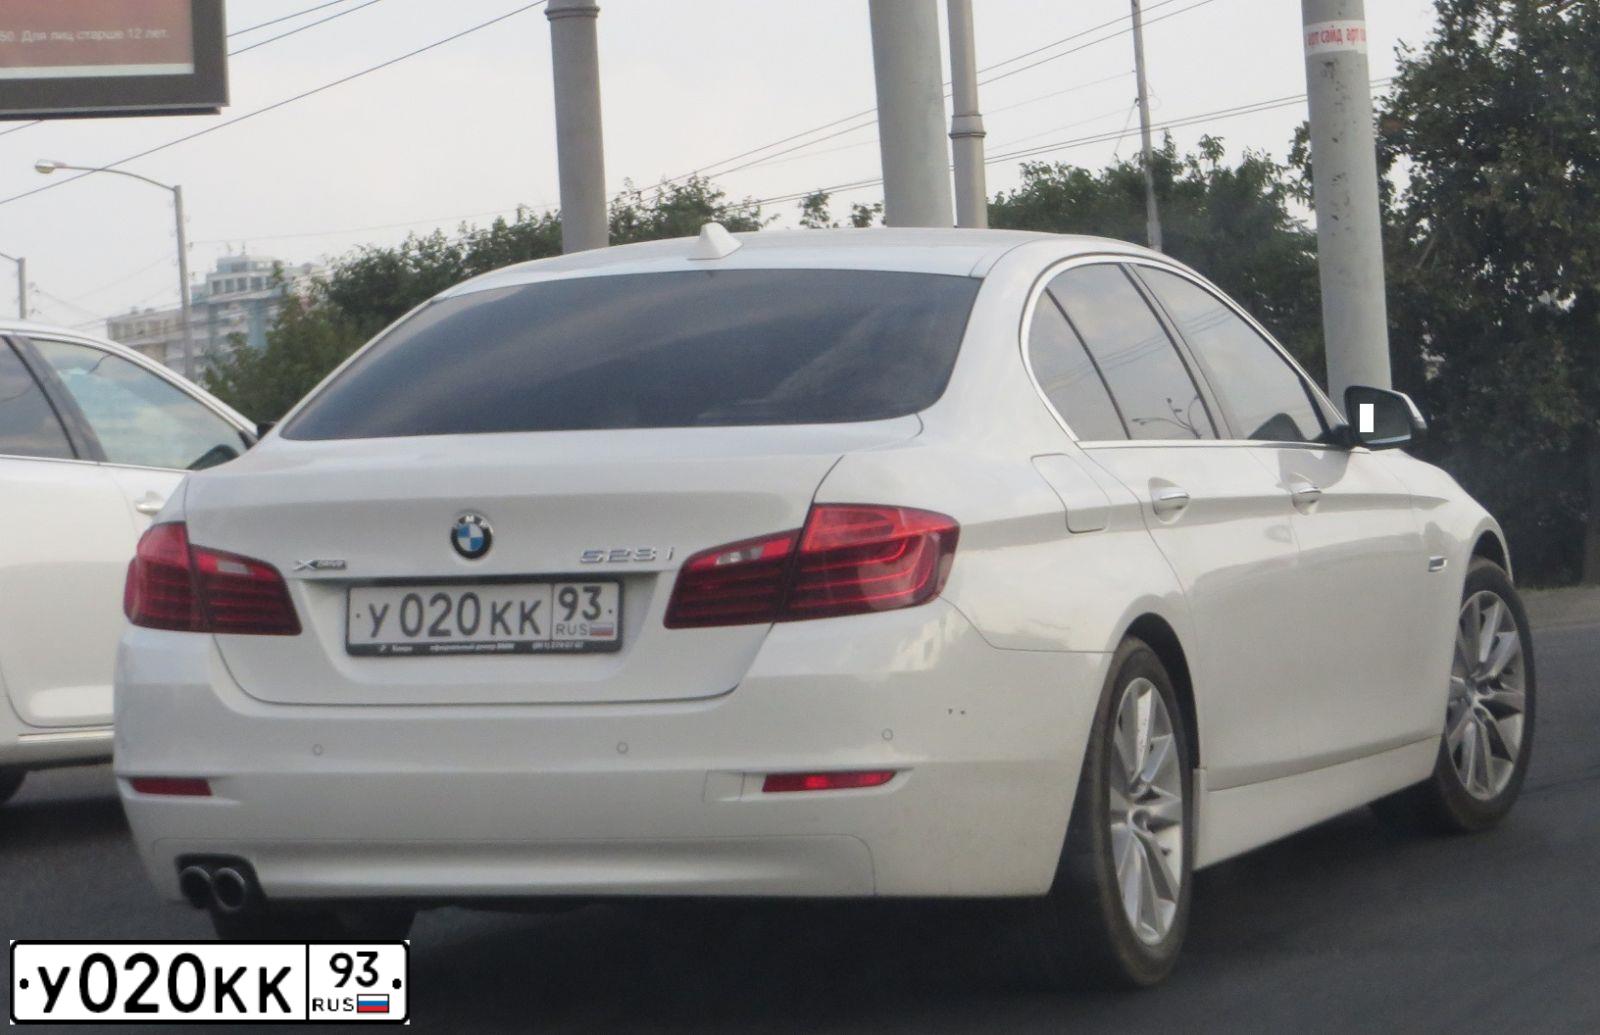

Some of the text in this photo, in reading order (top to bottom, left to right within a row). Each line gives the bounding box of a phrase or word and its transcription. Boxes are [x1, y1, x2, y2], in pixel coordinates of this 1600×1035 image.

[21, 29, 47, 43] Для
[76, 29, 124, 41] старше
[128, 27, 142, 40] 12
[557, 586, 601, 621] 93
[555, 624, 588, 637] RUS
